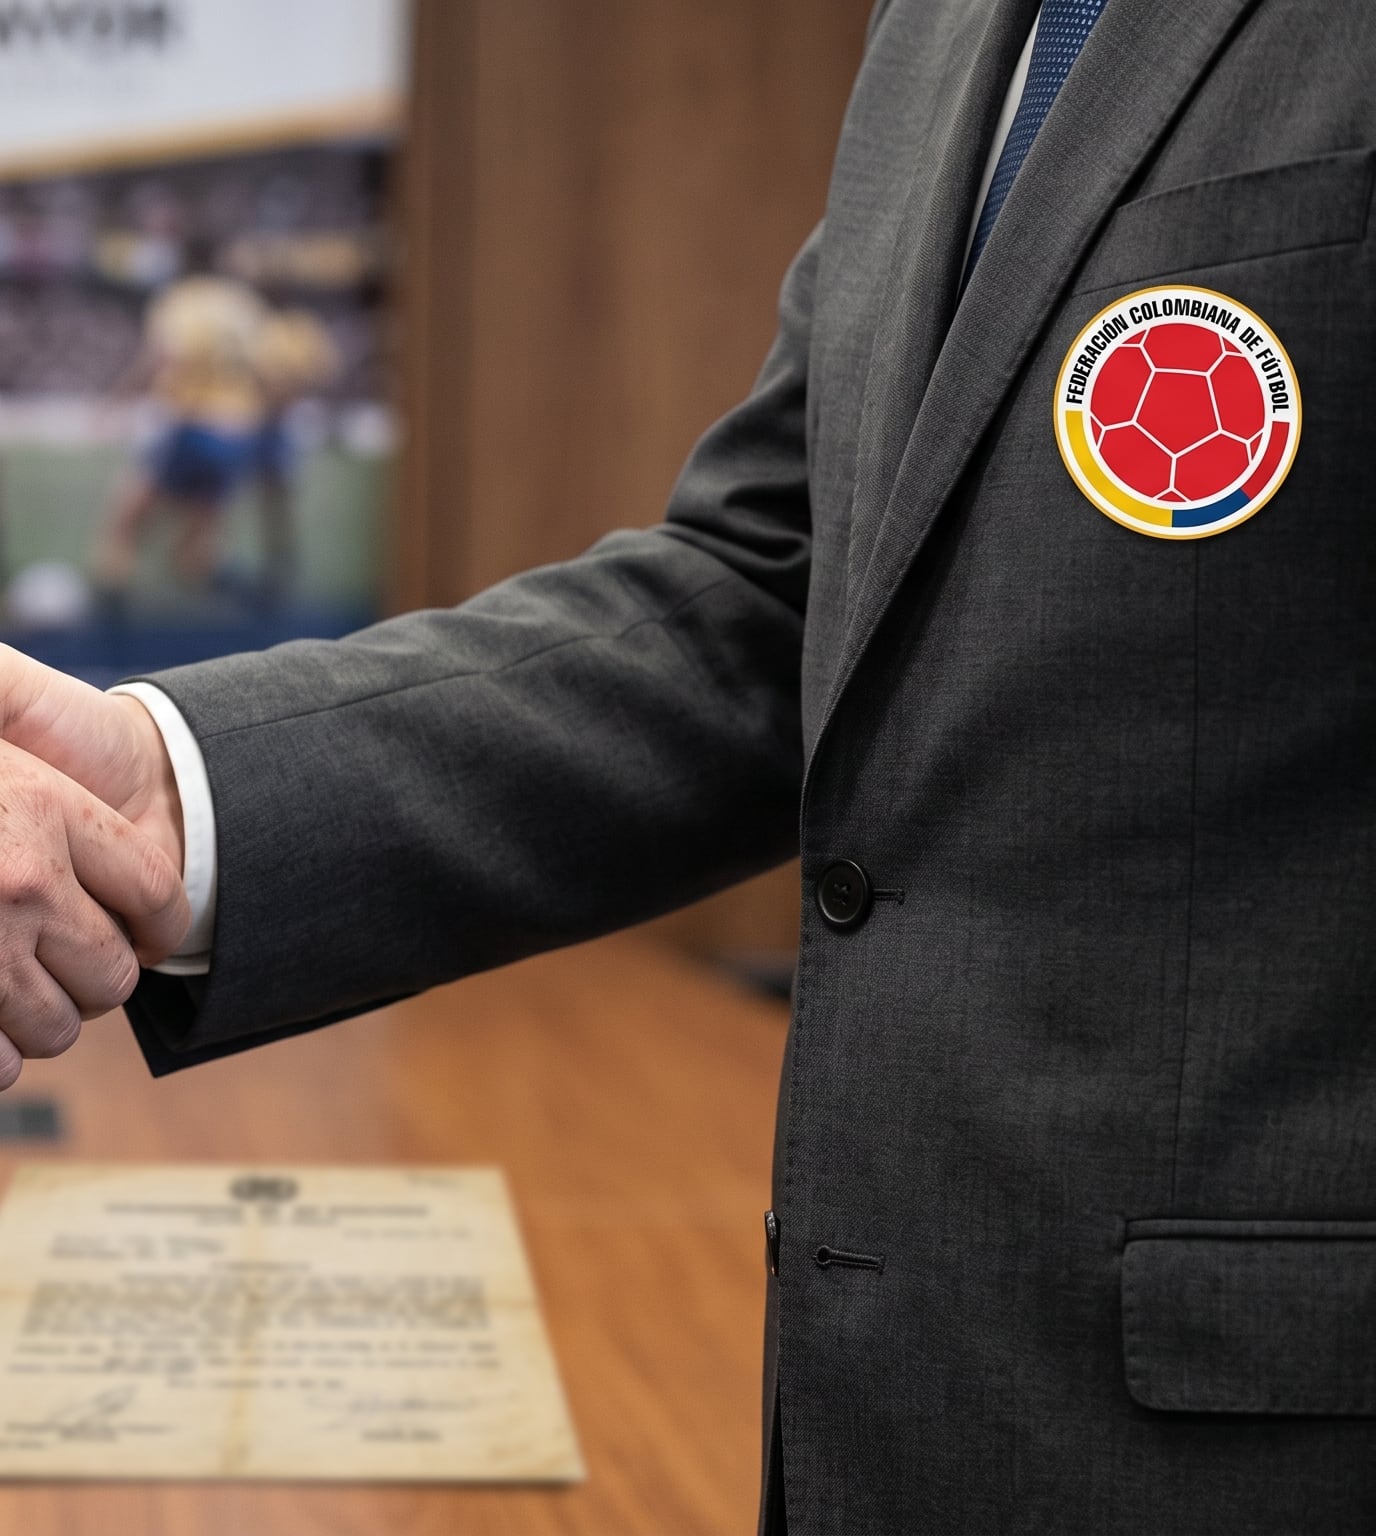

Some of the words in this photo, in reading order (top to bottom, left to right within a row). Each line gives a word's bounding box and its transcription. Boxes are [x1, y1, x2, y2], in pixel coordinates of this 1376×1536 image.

[1066, 313, 1130, 405] FEDERACIÓN
[1128, 298, 1241, 334] COLOMBIANA
[1238, 326, 1264, 352] DE
[1255, 347, 1290, 414] FÚTBOL
